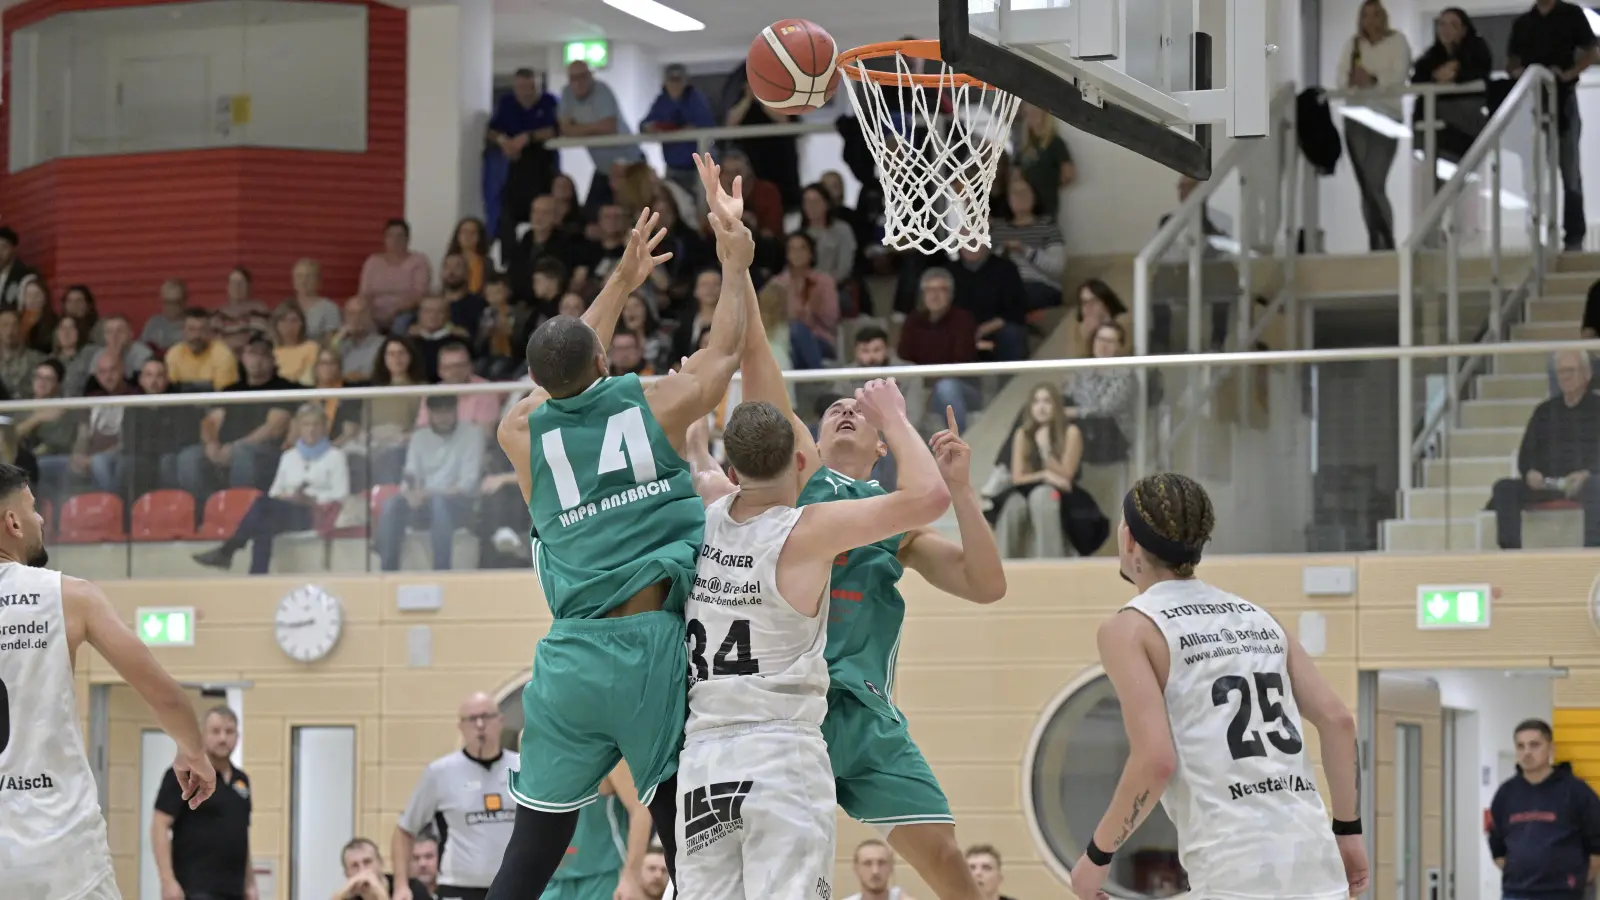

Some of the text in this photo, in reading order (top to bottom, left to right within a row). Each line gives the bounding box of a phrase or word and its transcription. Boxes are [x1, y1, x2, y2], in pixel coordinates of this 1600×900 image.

[541, 406, 657, 511] 14
[558, 479, 671, 527] HAPA ANSBACH
[0, 620, 48, 635] rendel
[0, 638, 48, 650] endel.de
[687, 619, 759, 680] 34
[1180, 632, 1223, 650] Allianz
[1212, 672, 1303, 760] 25
